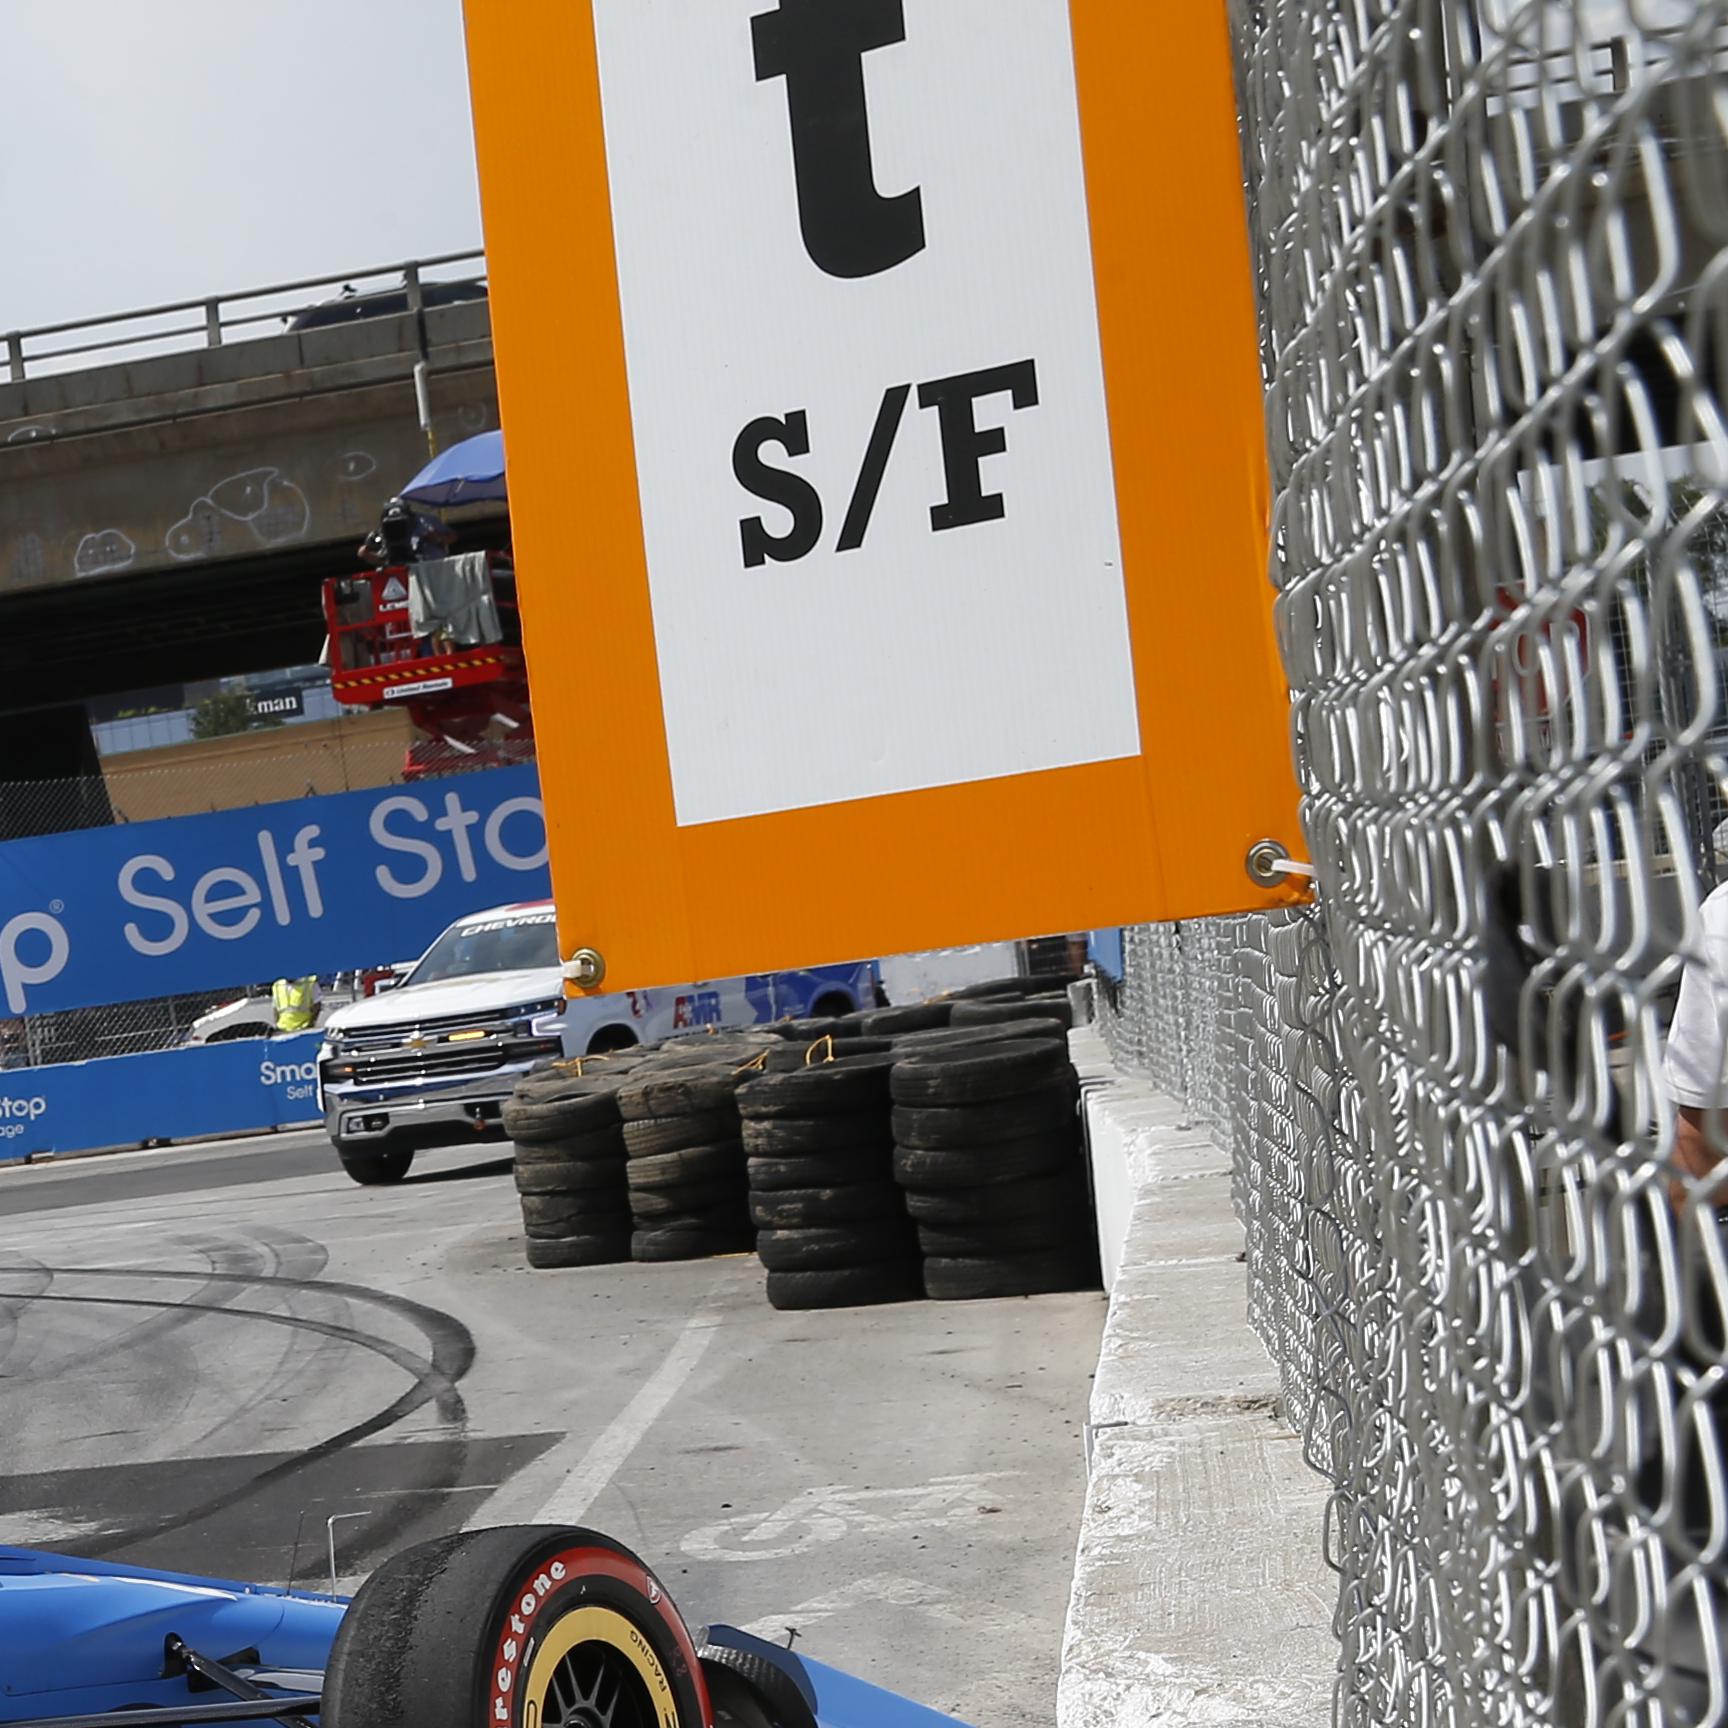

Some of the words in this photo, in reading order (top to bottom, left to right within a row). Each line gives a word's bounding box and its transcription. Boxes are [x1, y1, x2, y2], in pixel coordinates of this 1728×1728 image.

[731, 357, 1040, 568] S/F
[117, 824, 327, 956] Self
[286, 1084, 314, 1100] Self
[628, 1629, 668, 1693] RACING
